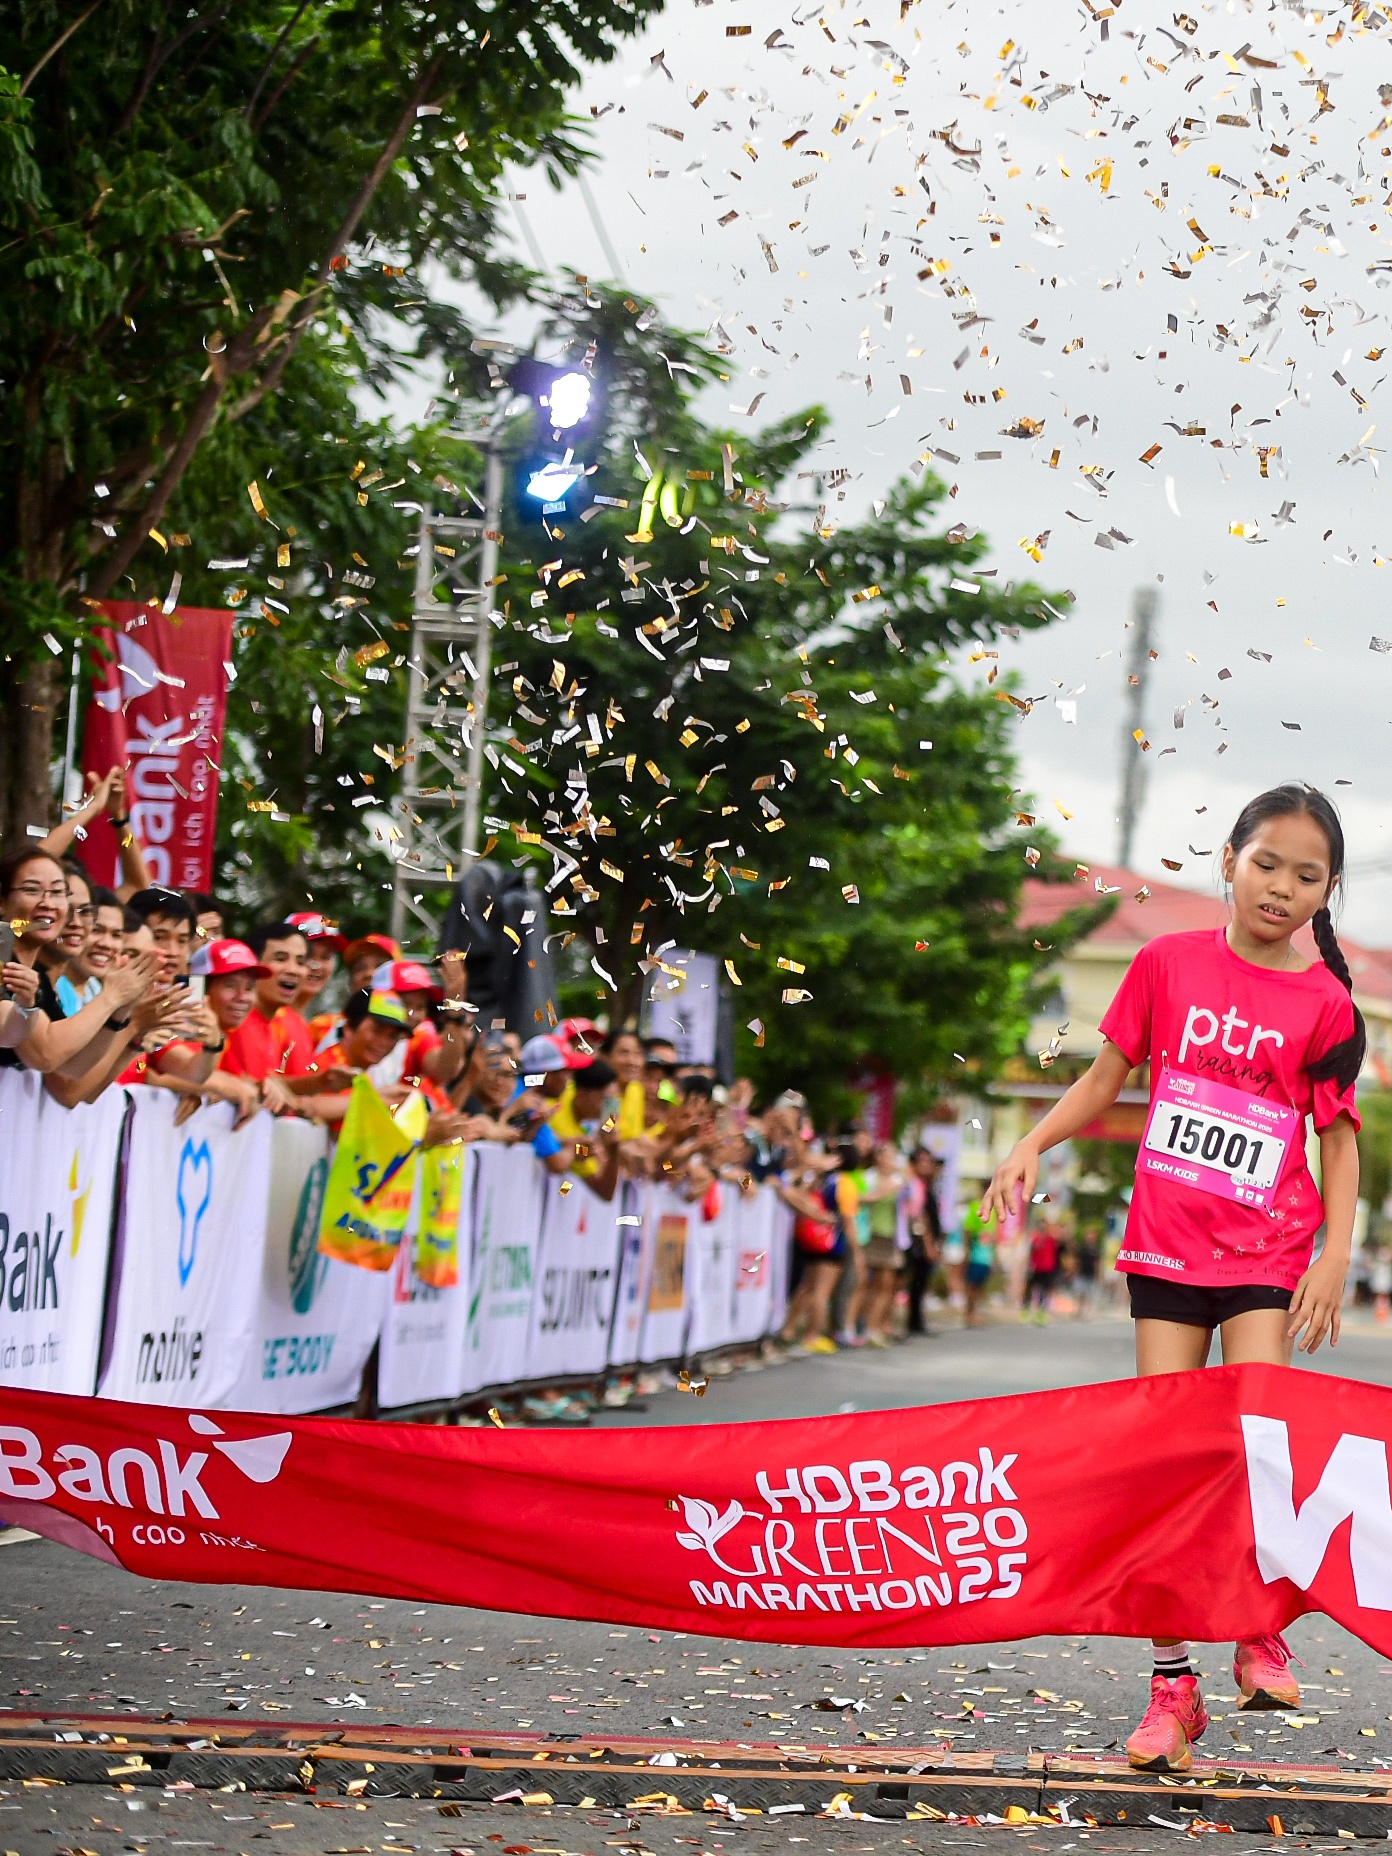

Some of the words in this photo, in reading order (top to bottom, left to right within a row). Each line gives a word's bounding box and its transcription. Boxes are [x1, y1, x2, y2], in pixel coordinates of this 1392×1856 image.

[1178, 1005, 1284, 1064] ptr
[1197, 1050, 1276, 1098] racing
[1174, 1096, 1200, 1110] HDBANK
[1200, 1103, 1221, 1116] GREEN
[1222, 1110, 1258, 1128] MARATHON
[1248, 1102, 1279, 1121] HDBank
[1167, 1114, 1264, 1175] 15001
[1134, 1251, 1185, 1269] RUNNERS
[755, 1446, 1019, 1514] HDBank
[132, 1524, 185, 1545] cao
[702, 1512, 943, 1577] GREEN
[943, 1507, 1029, 1556] 20
[689, 1571, 953, 1612] MARATHON
[957, 1552, 1028, 1604] 25
